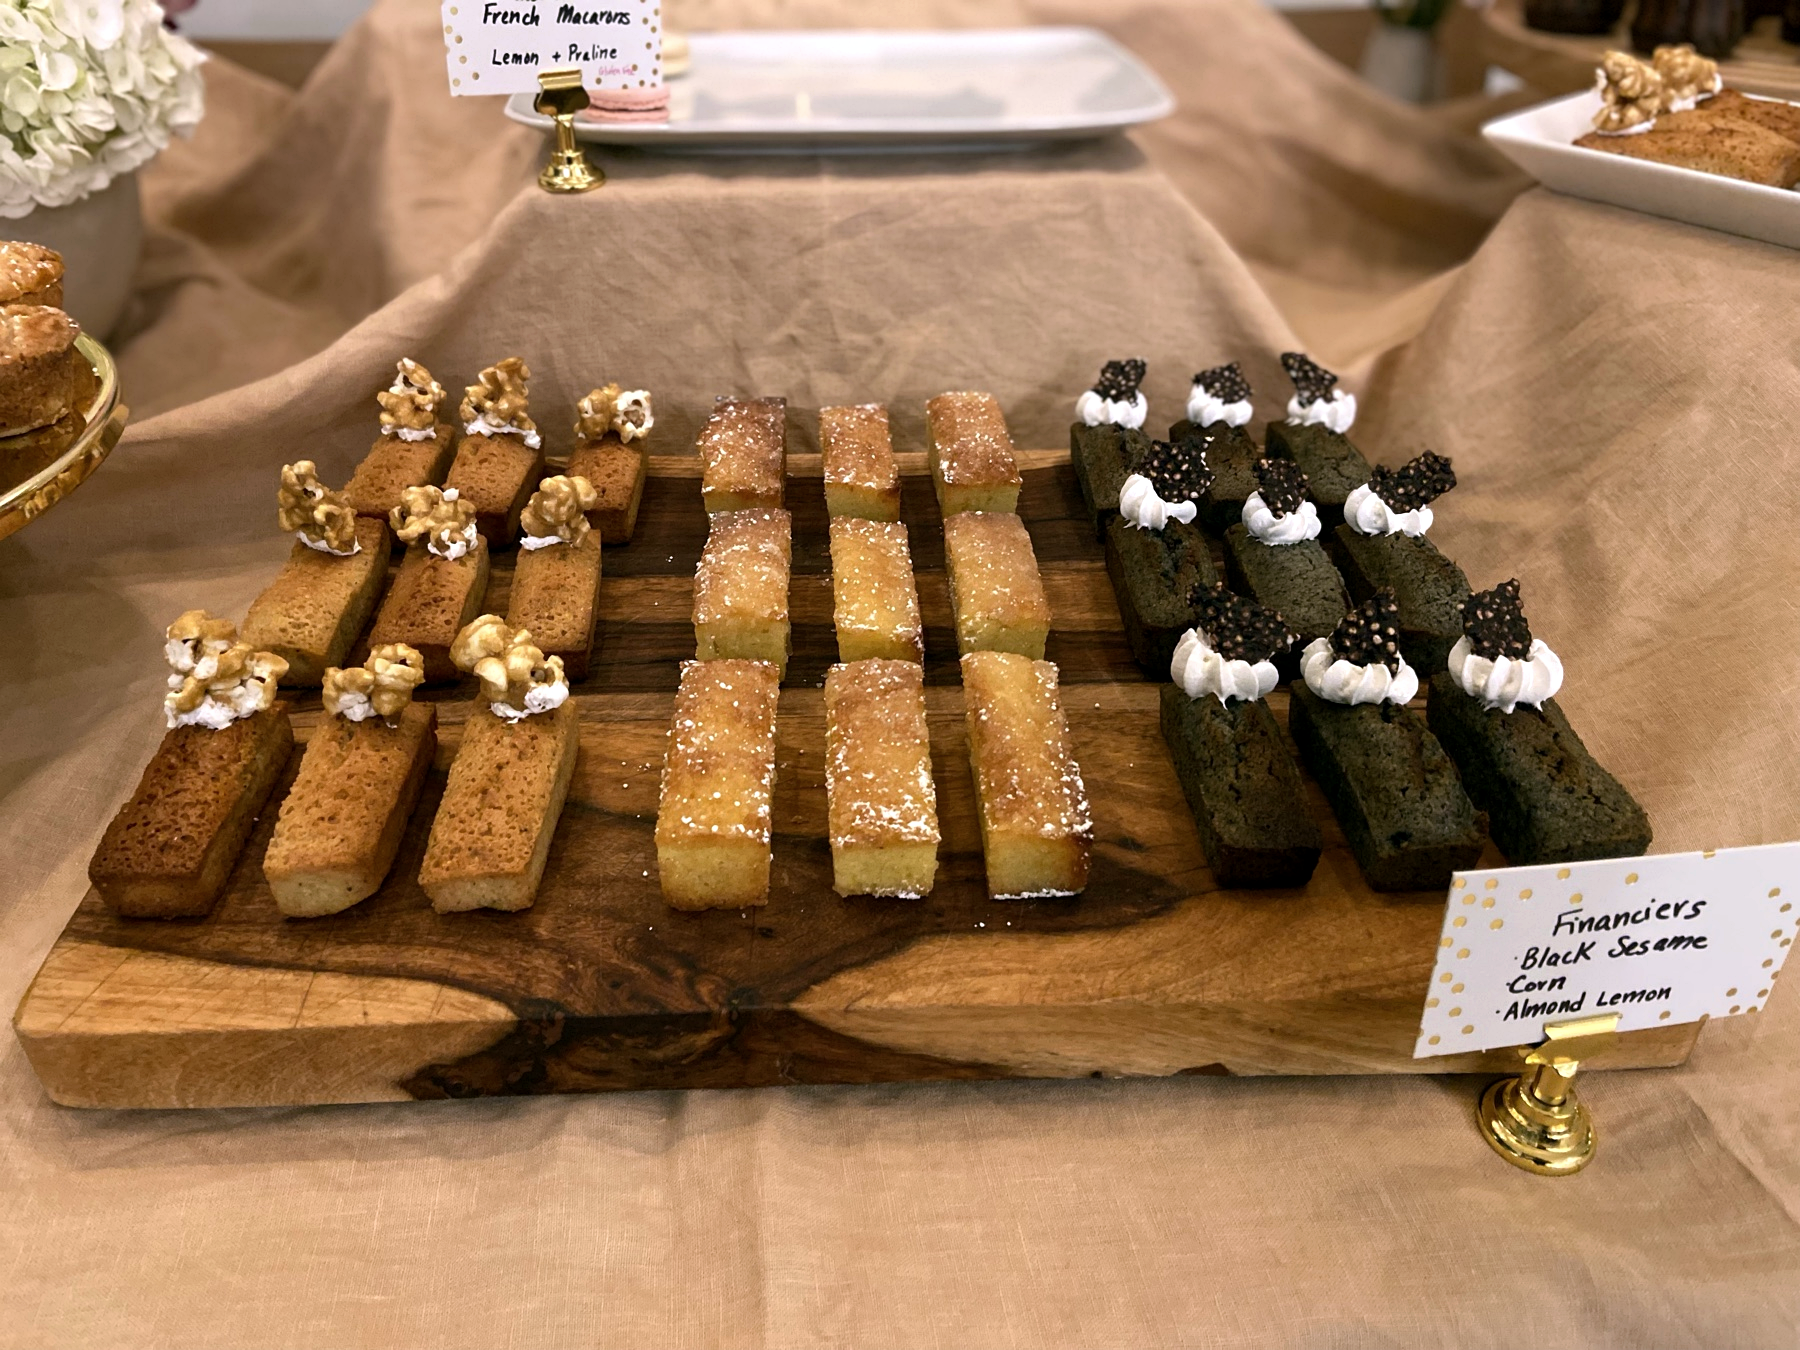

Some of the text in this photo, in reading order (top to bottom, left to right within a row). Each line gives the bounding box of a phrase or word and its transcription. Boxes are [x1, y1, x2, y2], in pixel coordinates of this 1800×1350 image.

[482, 2, 632, 27] French Macarons
[492, 43, 618, 66] Lemon + Praline
[1552, 898, 1708, 937] Financiers
[1520, 934, 1709, 971] Black Sesame
[1508, 975, 1567, 994] Corn
[1503, 985, 1673, 1022] Almond Lemon
